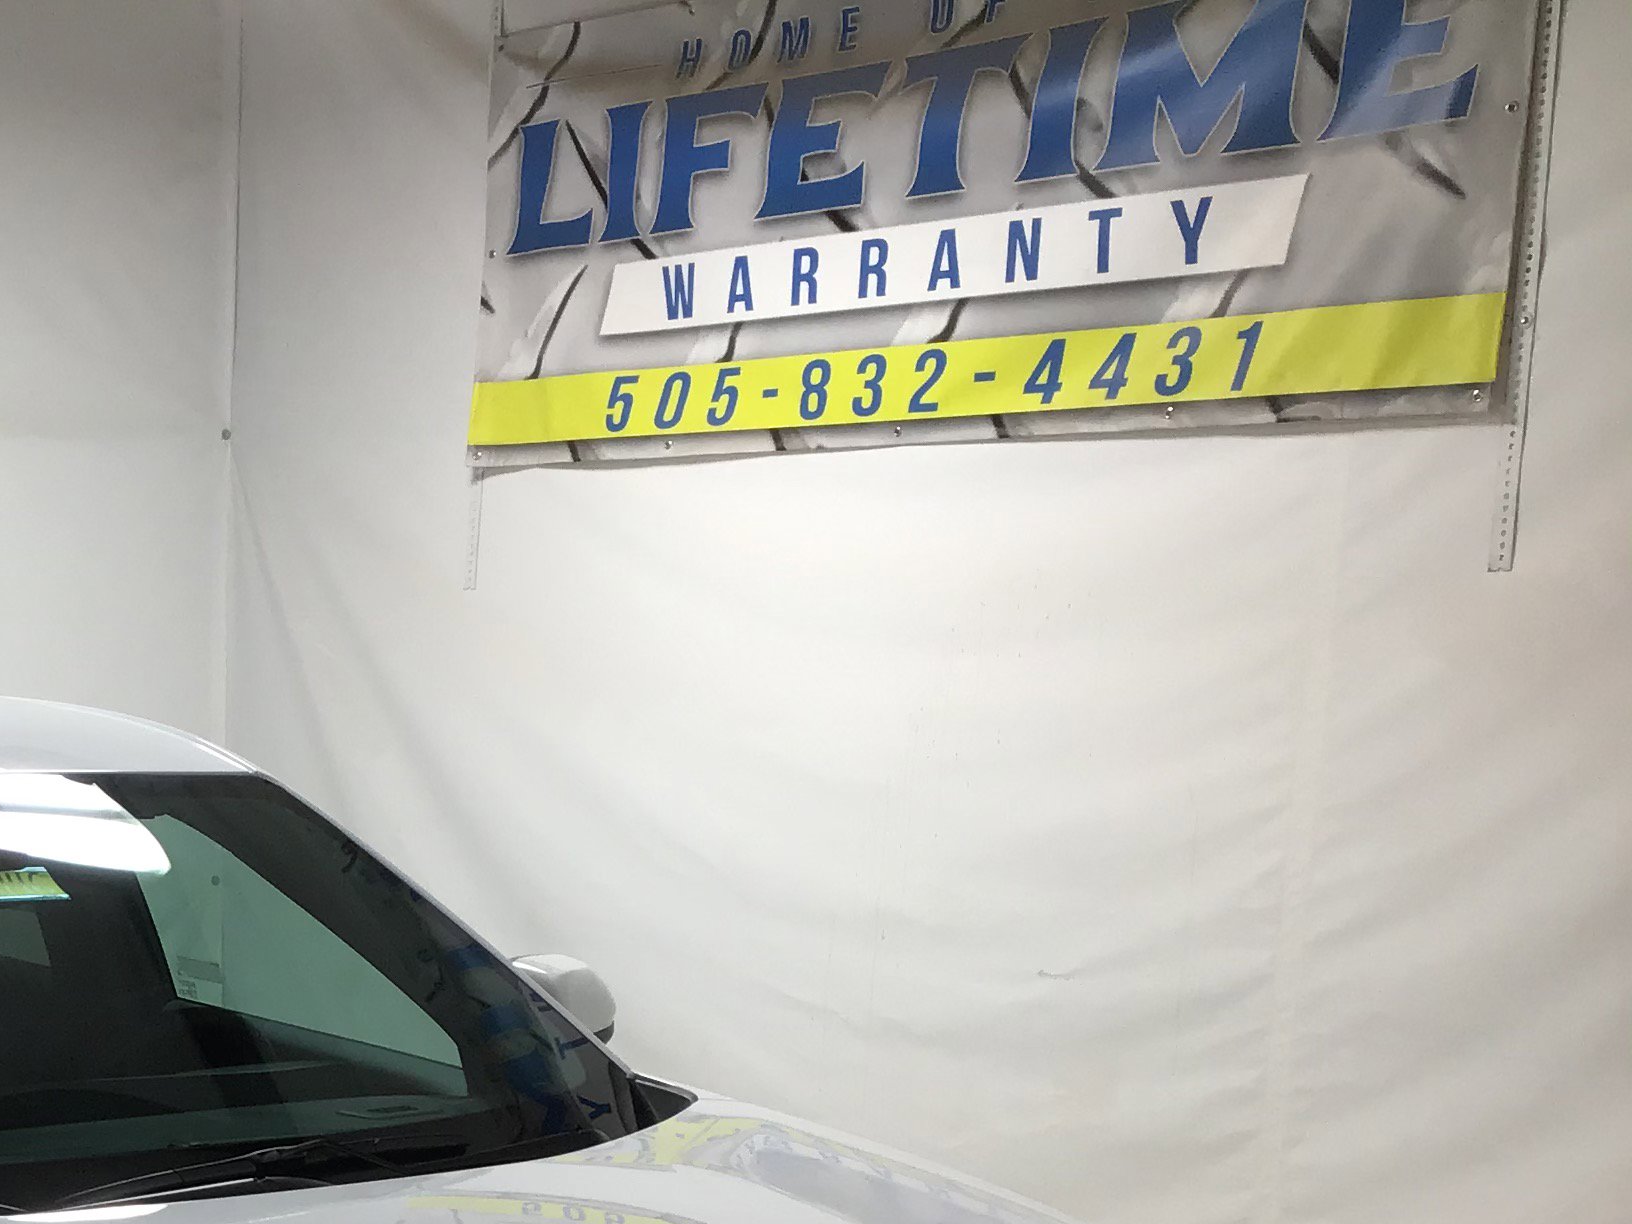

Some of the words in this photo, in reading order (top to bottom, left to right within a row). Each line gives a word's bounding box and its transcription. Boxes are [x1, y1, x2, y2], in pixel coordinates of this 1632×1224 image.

[676, 5, 862, 79] HOME
[506, 0, 1479, 257] LIFETIME
[661, 195, 1214, 321] WARRANTY
[604, 320, 1265, 433] 505-832-4431
